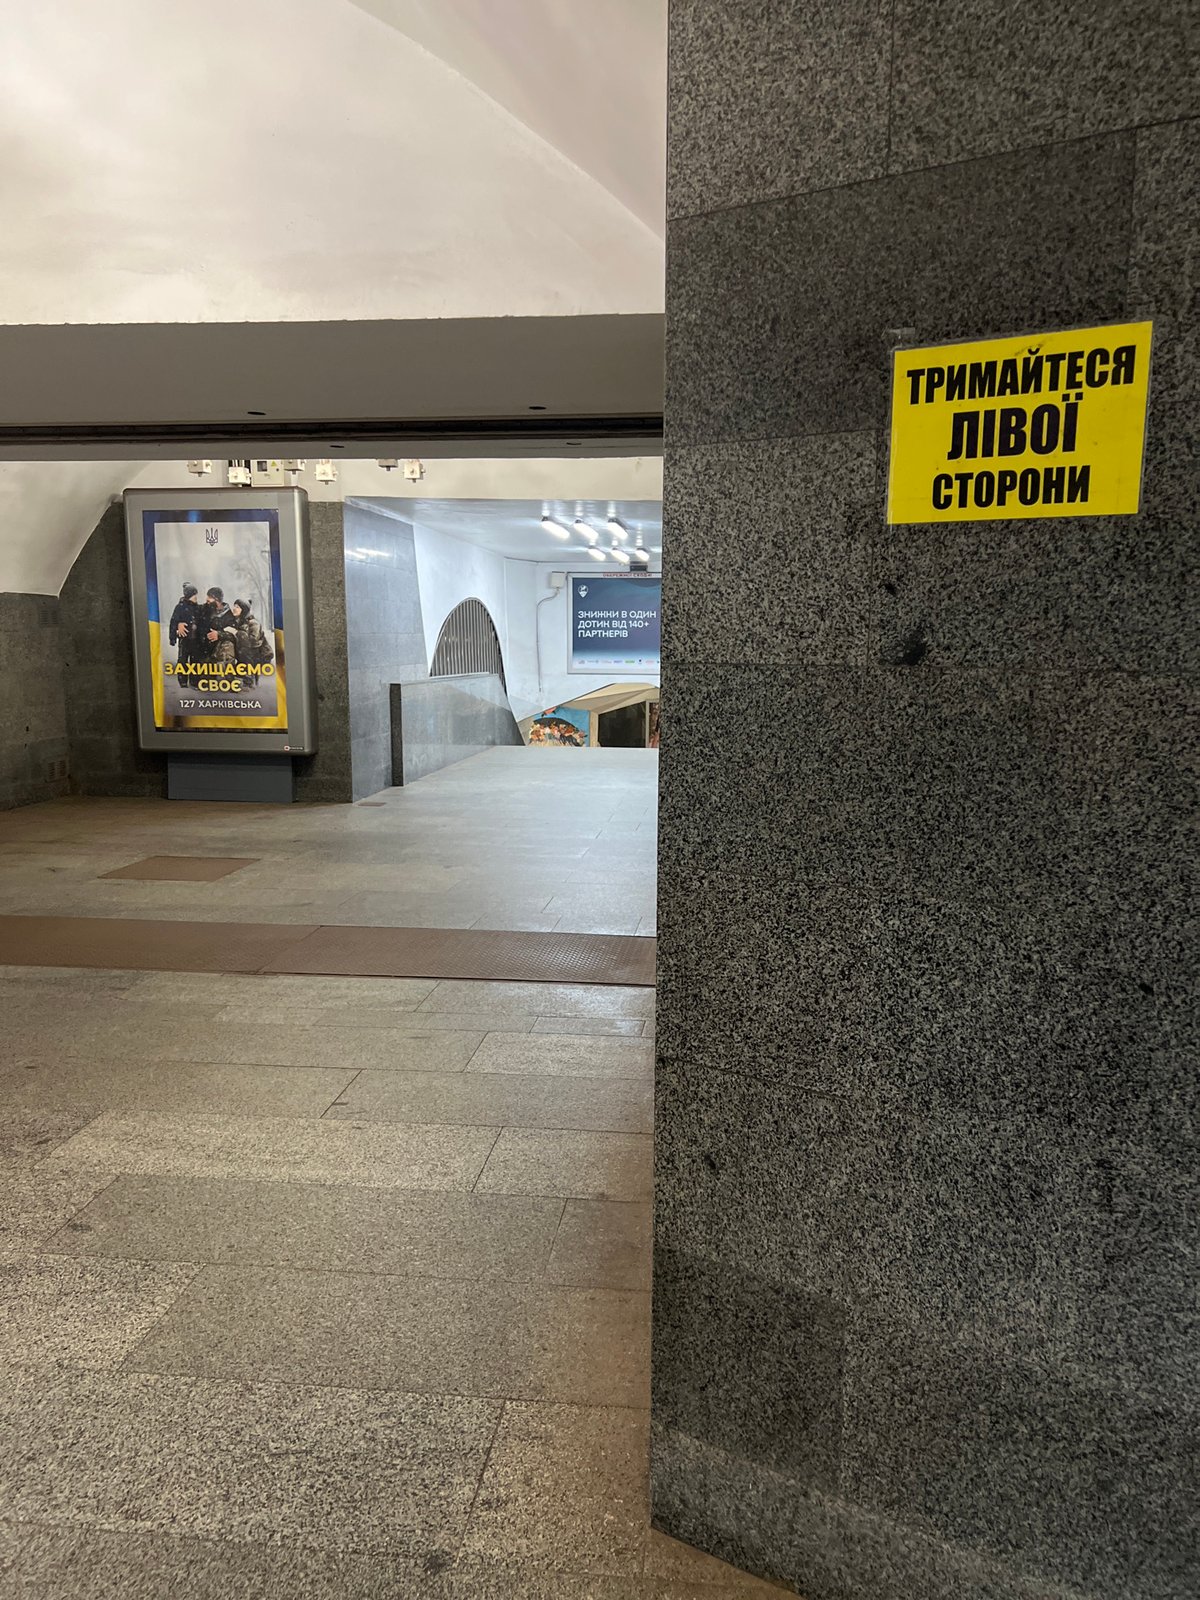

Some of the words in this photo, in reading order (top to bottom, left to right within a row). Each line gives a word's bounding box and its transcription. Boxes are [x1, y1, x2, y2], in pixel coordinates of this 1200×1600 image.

[907, 345, 1136, 405] ТРИМАЙТЕСЯ
[948, 393, 1083, 460] ЛІВОЇ
[932, 465, 1090, 510] СТОРОНИ
[629, 611, 656, 619] ОДИН
[578, 621, 610, 629] ДОТИК
[612, 621, 627, 629] ВІД
[165, 663, 274, 677] ЗАХИЩАЄМО
[198, 680, 241, 692] СВОЄ
[180, 700, 195, 708] 127
[198, 700, 261, 709] ХАРКІВСЬКА
